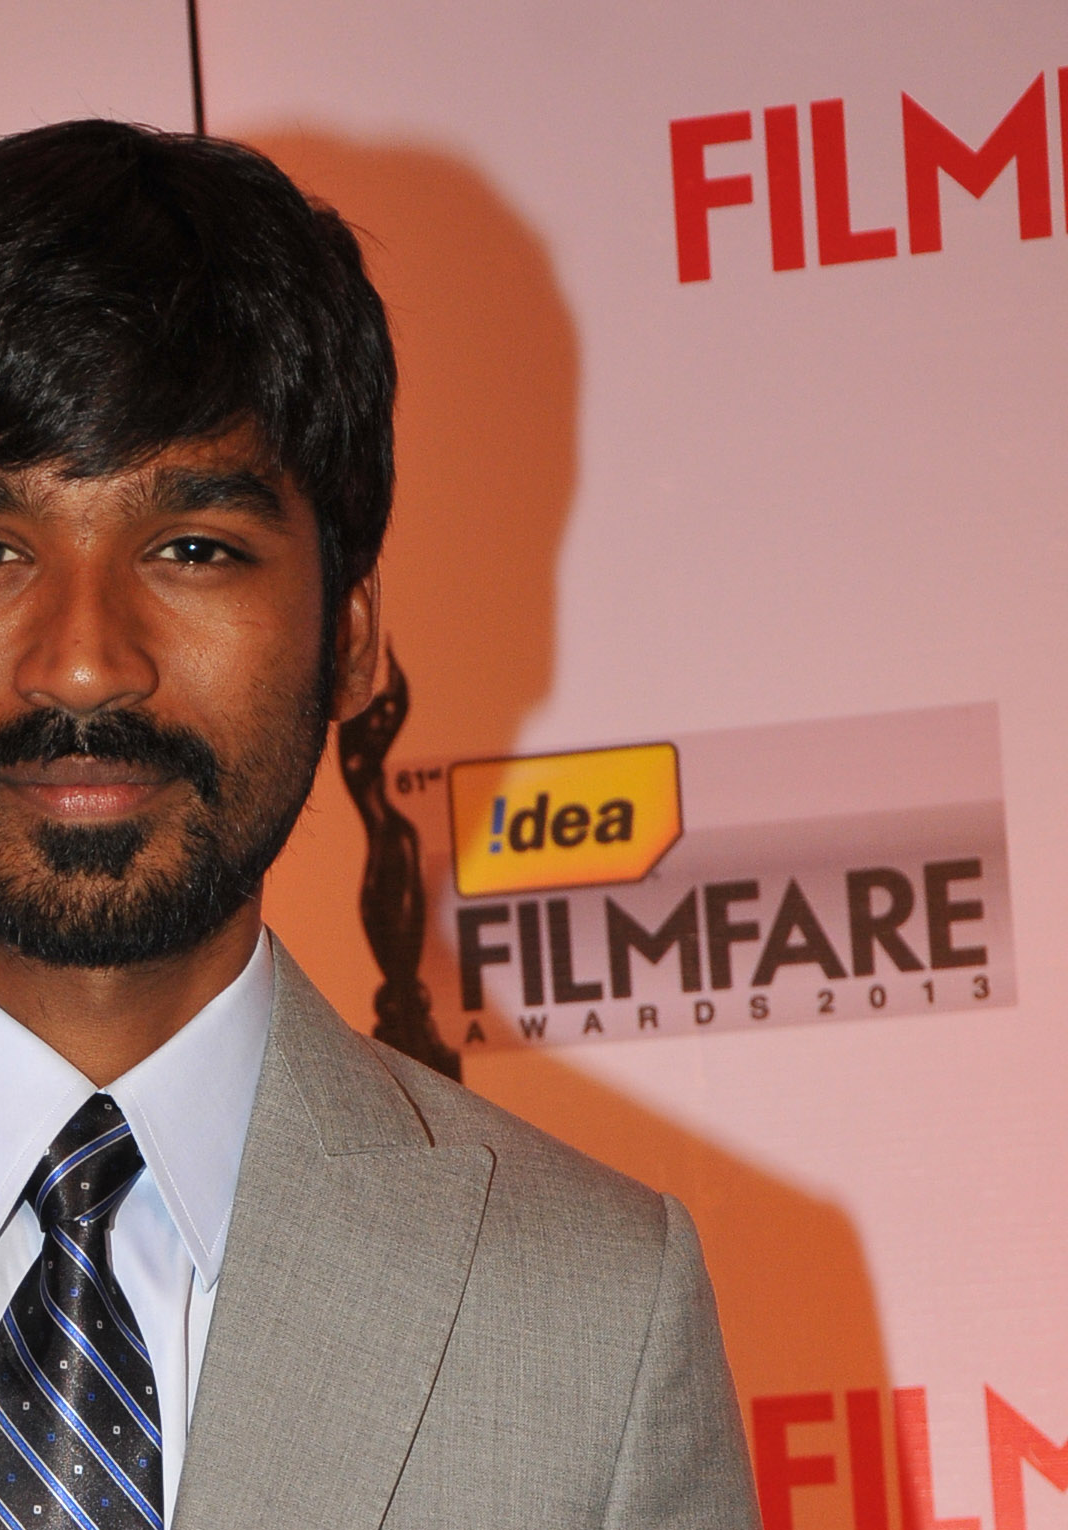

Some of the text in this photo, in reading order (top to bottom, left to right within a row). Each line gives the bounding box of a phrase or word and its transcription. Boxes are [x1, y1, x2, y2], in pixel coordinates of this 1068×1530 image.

[669, 65, 1068, 285] FILM
[488, 790, 635, 855] !dea
[455, 857, 988, 1012] FILMFARE
[463, 975, 991, 1046] AWARDS 2013
